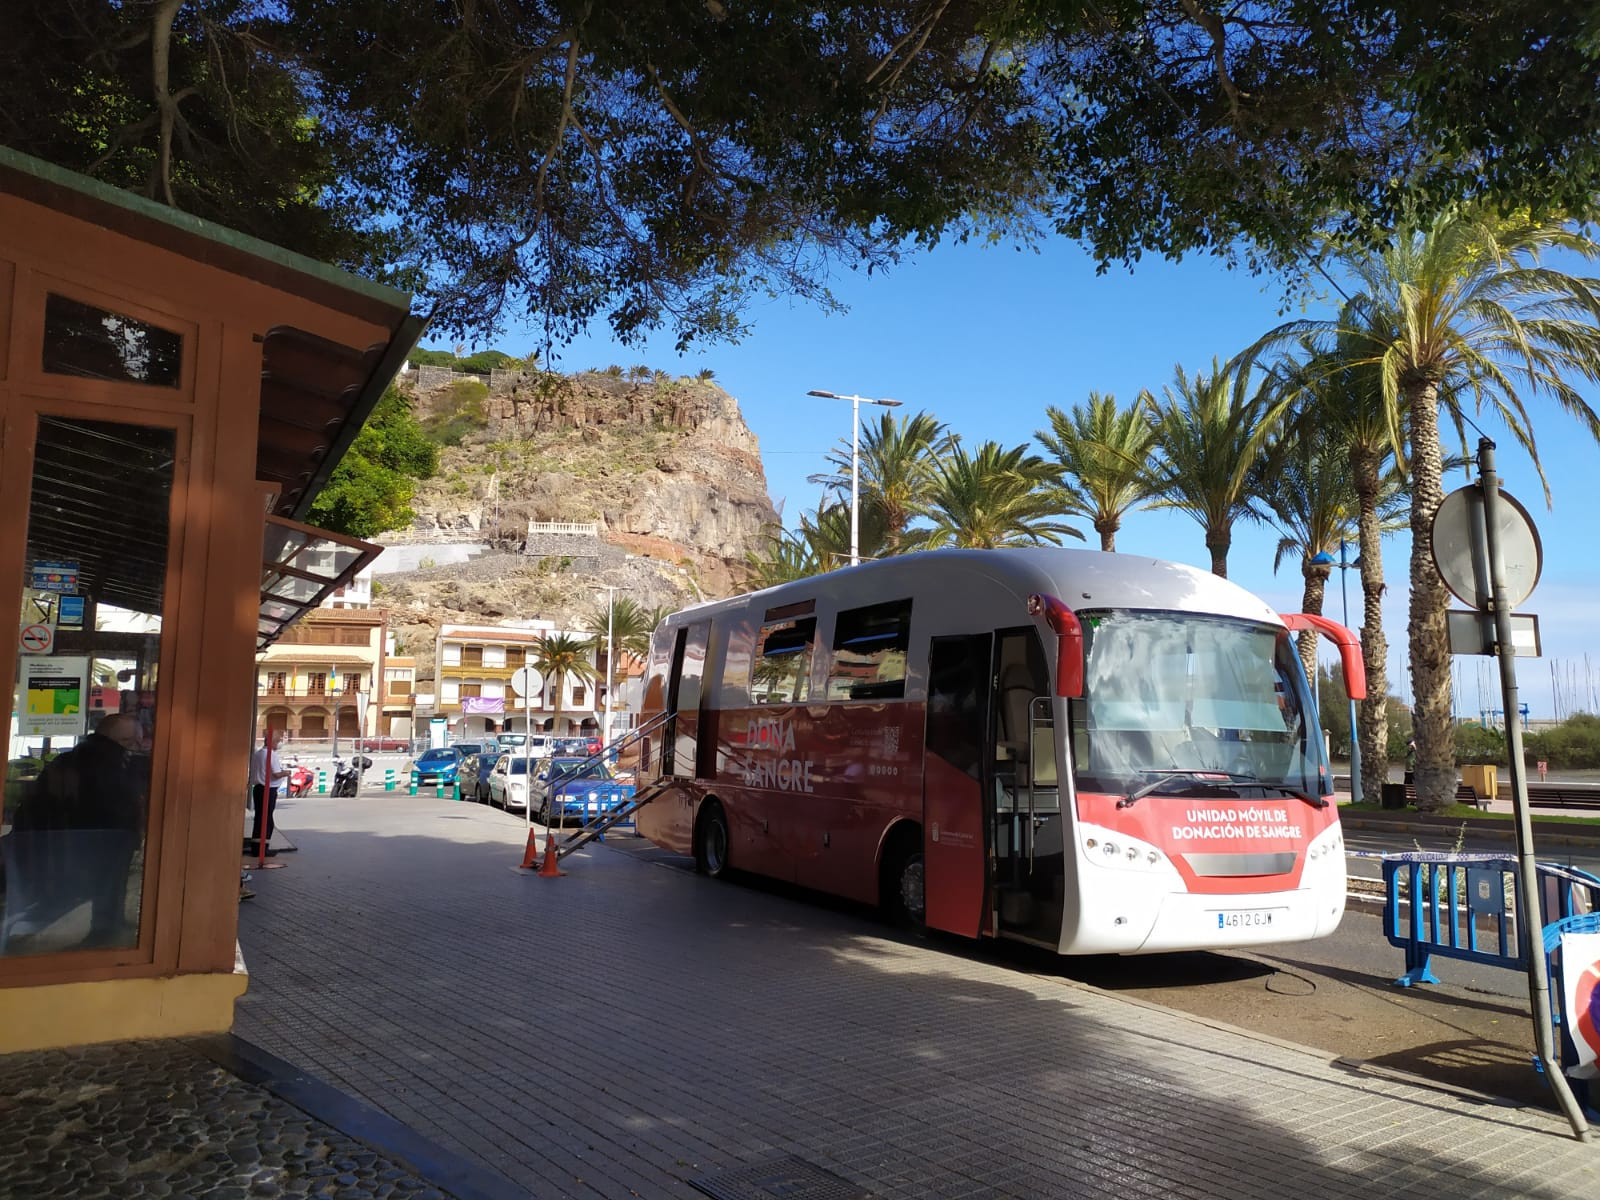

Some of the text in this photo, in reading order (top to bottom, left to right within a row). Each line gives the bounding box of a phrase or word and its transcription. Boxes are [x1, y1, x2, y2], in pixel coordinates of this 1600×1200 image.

[746, 719, 796, 752] DONA
[744, 757, 814, 793] SANGRE
[1186, 807, 1287, 822] UNIDAD MÓVIL DE
[1172, 823, 1302, 839] DONACIÓN DE SANGRE
[1225, 914, 1251, 927] 4612
